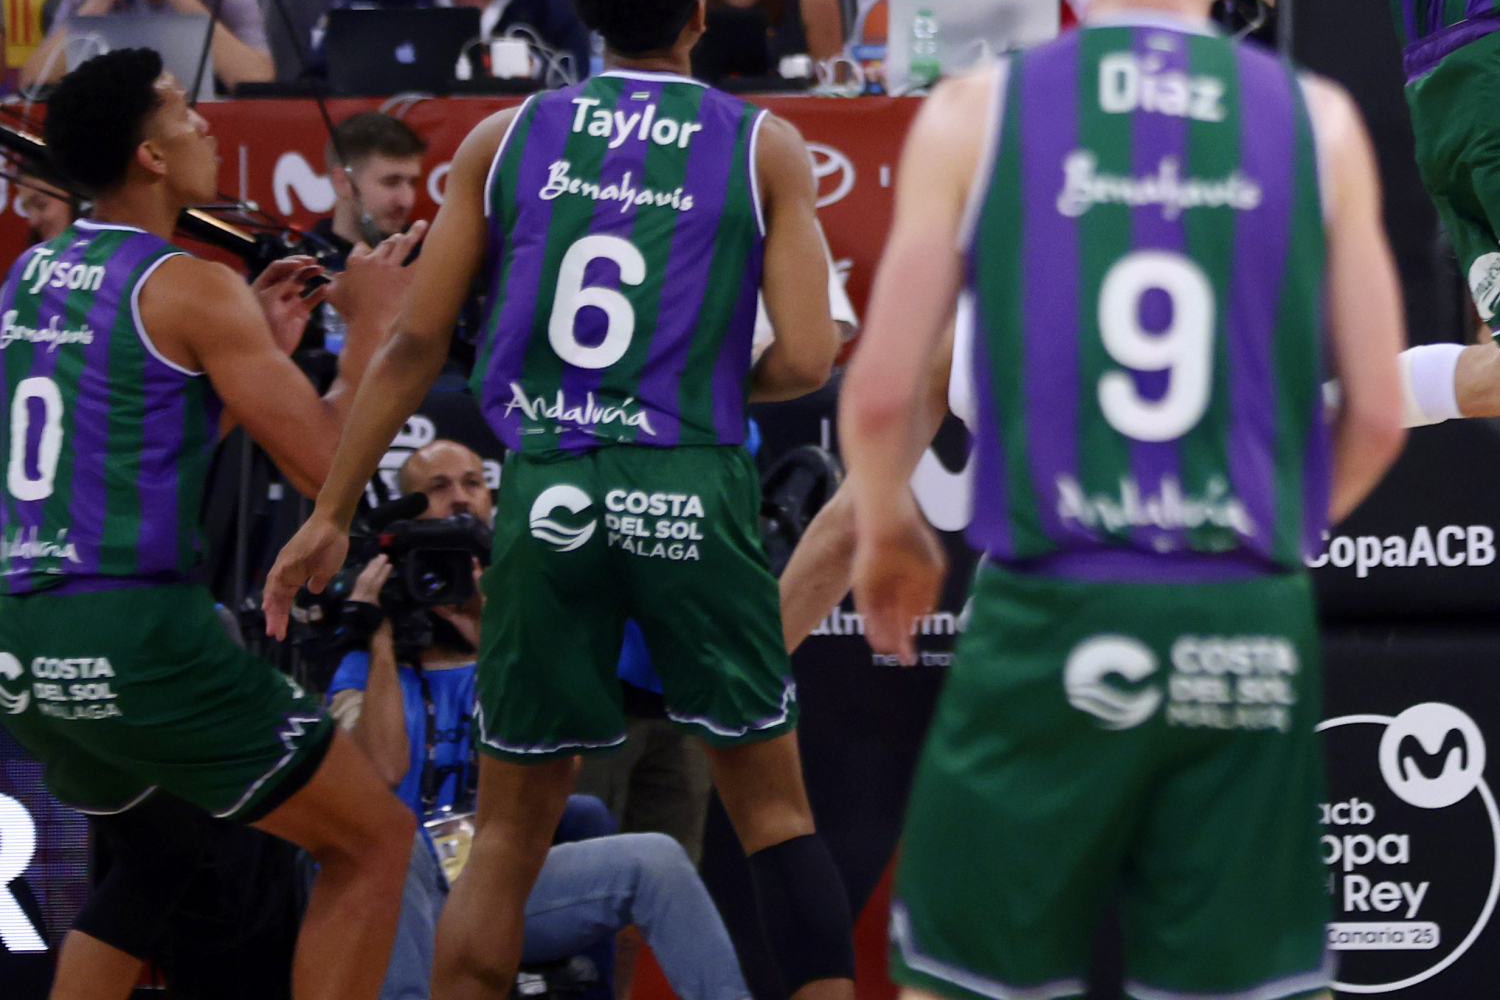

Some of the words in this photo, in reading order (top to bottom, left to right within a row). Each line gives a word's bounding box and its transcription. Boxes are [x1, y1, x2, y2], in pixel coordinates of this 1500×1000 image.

[572, 98, 702, 149] Taylor
[22, 247, 106, 294] Tyson
[548, 235, 646, 369] 6
[1098, 249, 1217, 442] 9
[503, 382, 657, 436] Andalucía
[8, 376, 63, 501] 0
[604, 488, 705, 518] COSTA
[605, 517, 652, 538] DEL
[654, 519, 704, 541] SOL
[607, 533, 700, 562] MÁLAGA
[31, 656, 116, 680] COSTA
[1171, 634, 1299, 676] COSTA
[32, 682, 69, 701] DEL
[68, 682, 119, 701] SOL
[1320, 832, 1411, 873] opa
[1343, 872, 1431, 920] Rey
[1326, 926, 1405, 945] Canaria
